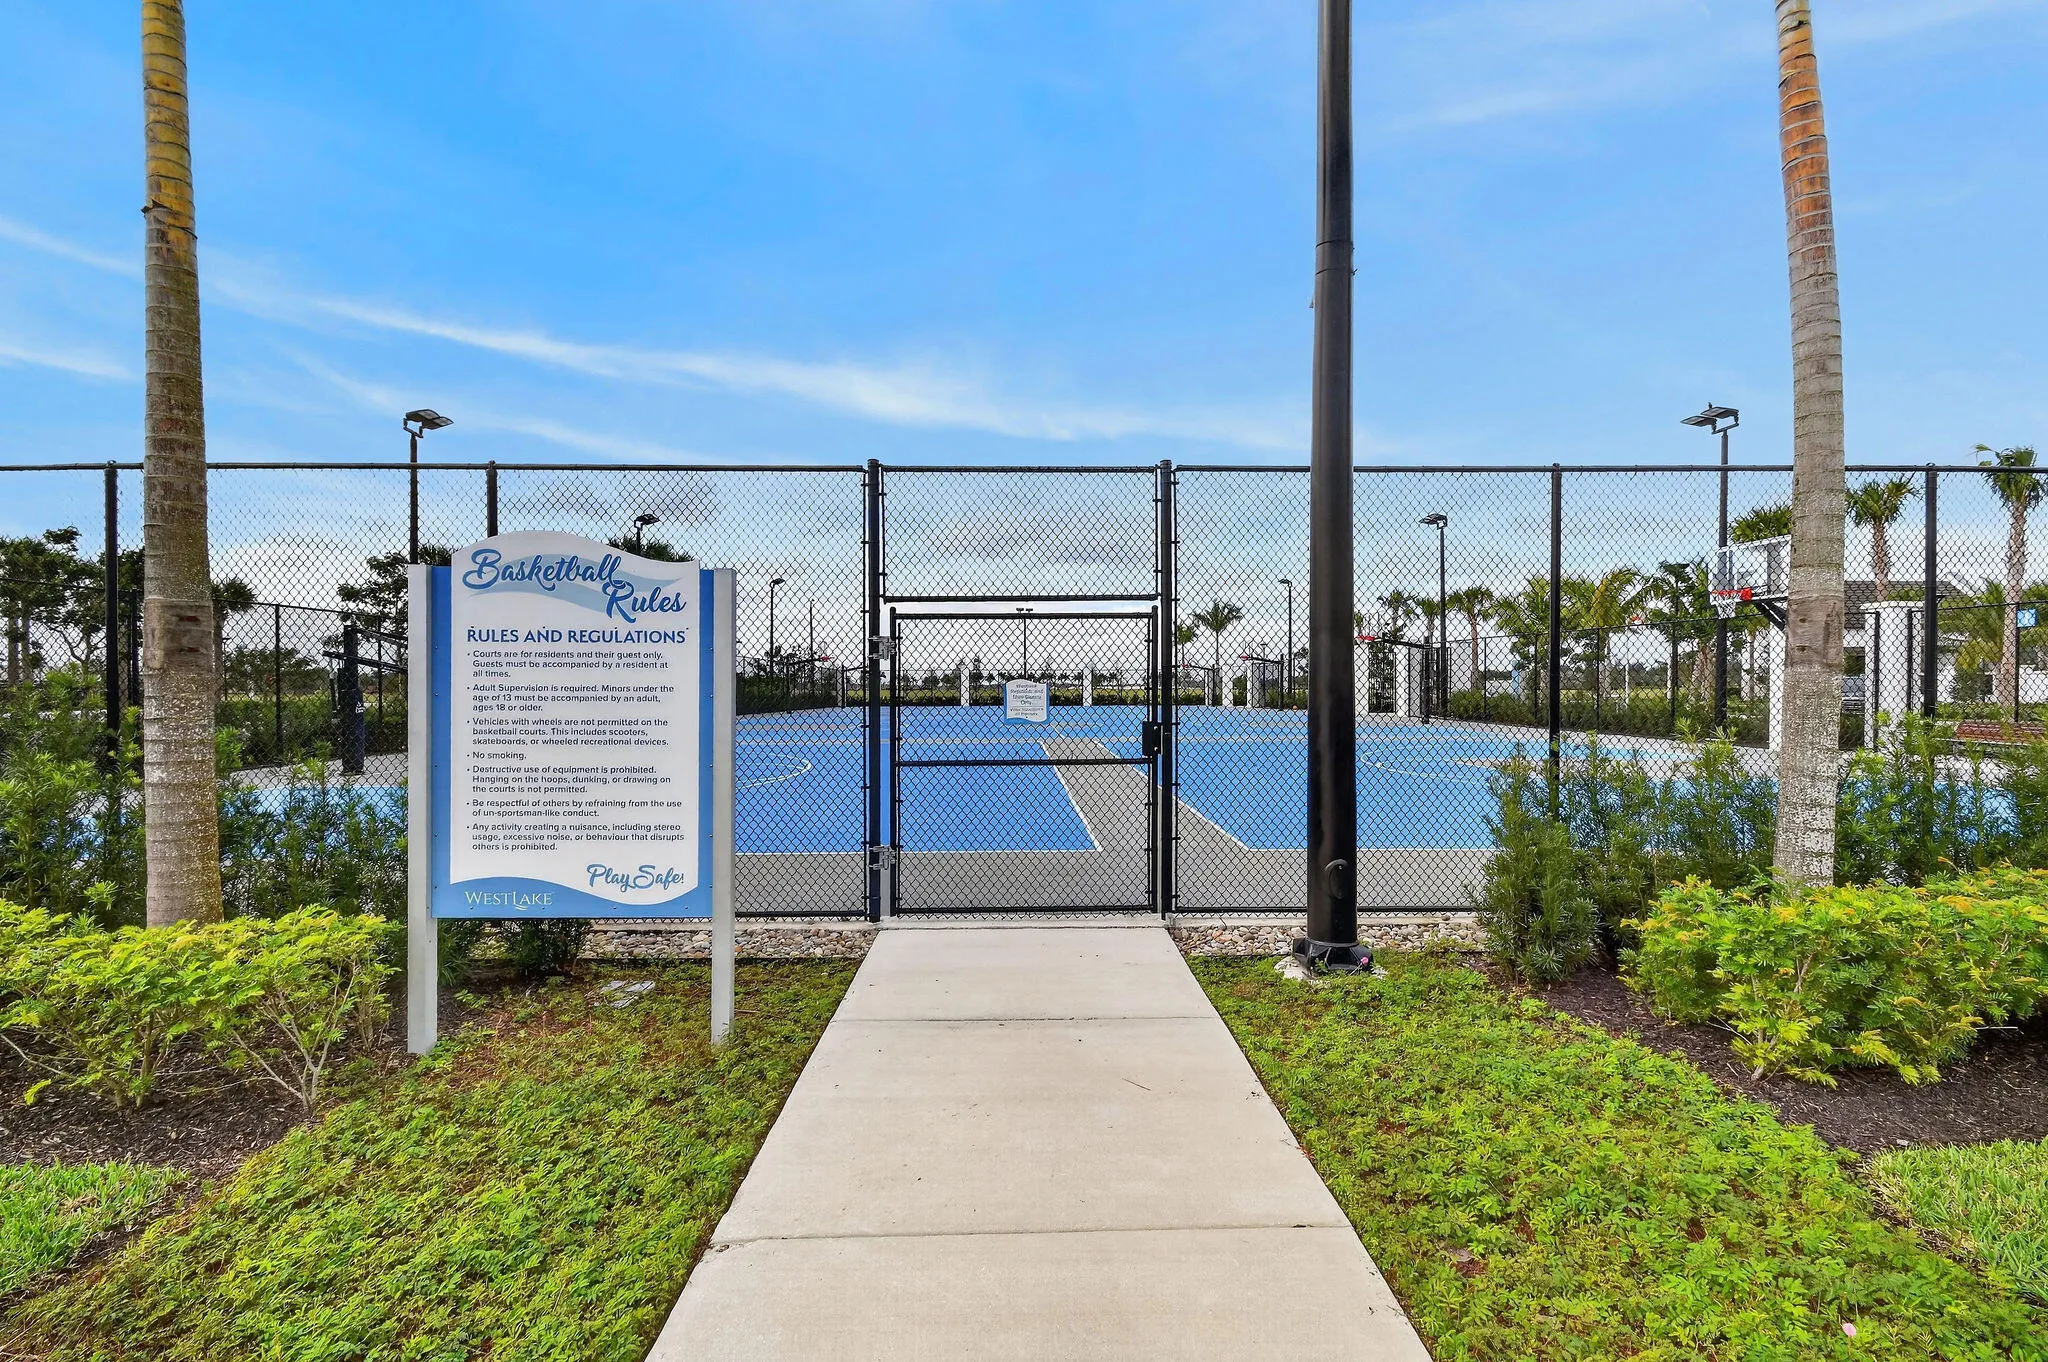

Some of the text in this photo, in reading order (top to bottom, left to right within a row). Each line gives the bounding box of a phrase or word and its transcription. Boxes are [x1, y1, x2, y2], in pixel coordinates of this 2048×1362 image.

[462, 548, 622, 591] Basketball
[602, 580, 687, 623] Rules
[467, 629, 685, 644] RULES AND REGULATIONS
[472, 649, 502, 658] Courts
[520, 649, 532, 658] for
[534, 649, 574, 658] residents
[576, 650, 592, 658] and
[594, 650, 614, 658] their
[616, 650, 641, 660] guest
[472, 659, 503, 668] Guests
[505, 659, 526, 668] must
[528, 659, 540, 668] be
[542, 660, 600, 670] accompanied
[602, 660, 613, 671] by
[622, 660, 657, 669] resident
[659, 660, 668, 669] at
[472, 669, 482, 678] all
[472, 683, 496, 692] Adult
[498, 683, 548, 694] Supervision
[550, 684, 558, 692] is
[601, 684, 630, 693] Minors
[632, 684, 658, 693] under
[660, 684, 674, 693] the
[472, 695, 489, 704] age
[491, 693, 500, 702] of
[502, 693, 512, 702] 13
[514, 693, 535, 702] must
[537, 693, 548, 702] be
[550, 694, 608, 704] accompanied
[610, 694, 621, 704] by
[472, 705, 493, 714] ages
[495, 703, 505, 712] 18
[472, 718, 509, 726] Vehicles
[510, 718, 530, 726] with
[531, 718, 562, 726] wheels
[580, 718, 595, 727] not
[596, 718, 638, 728] permitted
[653, 718, 668, 727] the
[472, 728, 517, 736] basketball
[550, 728, 569, 737] This
[570, 728, 606, 737] includes
[541, 737, 578, 746] wheeled
[580, 737, 631, 746] recreational
[472, 750, 485, 759] No
[472, 765, 521, 773] Destructive
[541, 765, 550, 773] of
[552, 765, 598, 775] equipment
[600, 765, 608, 774] is
[472, 775, 509, 785] Hanging
[524, 775, 538, 783] the
[622, 775, 658, 786] drawing
[472, 785, 486, 793] the
[488, 785, 516, 793] courts
[517, 785, 524, 793] is
[527, 785, 541, 793] not
[472, 799, 484, 807] Be
[486, 799, 529, 809] respectful
[531, 799, 540, 807] of
[542, 799, 570, 808] others
[571, 799, 583, 809] by
[584, 799, 626, 809] refraining
[628, 799, 648, 808] from
[650, 799, 664, 808] the
[472, 808, 481, 817] of
[472, 822, 489, 833] Any
[491, 822, 522, 833] activity
[524, 822, 559, 833] creating
[612, 823, 652, 833] including
[653, 823, 680, 832] stereo
[502, 832, 544, 841] excessive
[585, 833, 629, 842] behaviour
[631, 833, 648, 842] that
[649, 833, 684, 844] disrupts
[472, 842, 500, 851] others
[501, 842, 509, 851] is
[587, 863, 685, 892] Play Safe!
